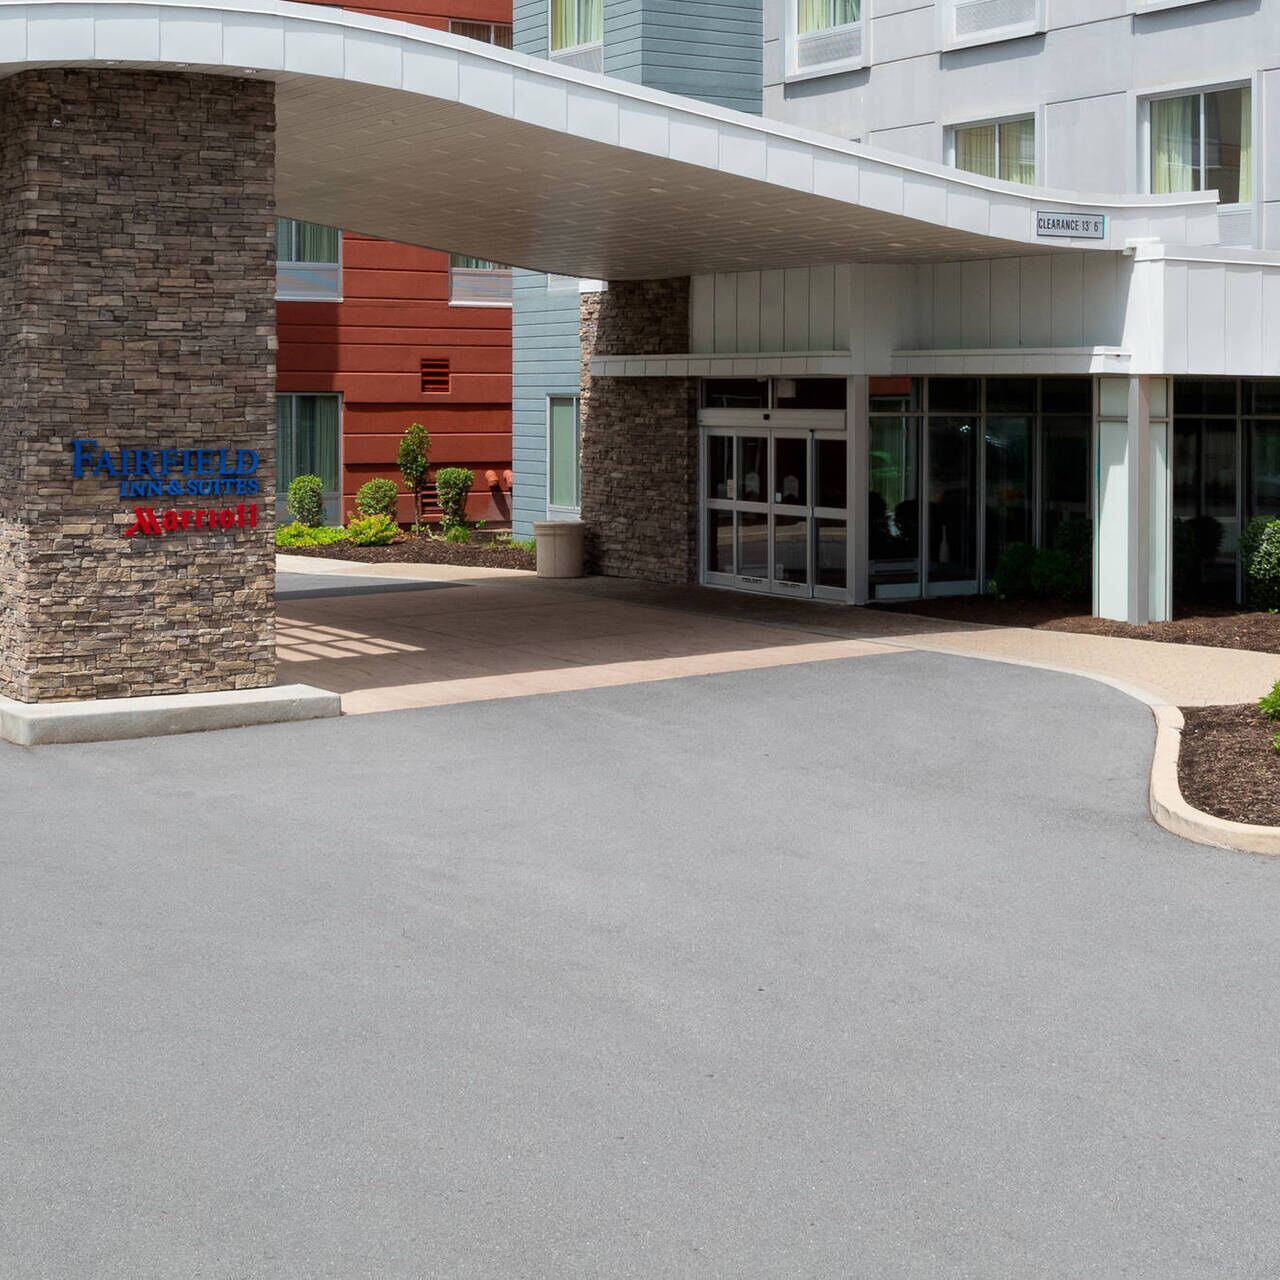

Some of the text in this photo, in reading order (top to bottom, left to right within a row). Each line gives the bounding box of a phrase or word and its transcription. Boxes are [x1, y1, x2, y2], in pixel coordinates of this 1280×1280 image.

[1038, 218, 1079, 231] CLEARANCE
[71, 439, 259, 480] FAIRFIELD
[120, 478, 259, 497] INN & SUITES
[122, 503, 257, 538] Marriott
